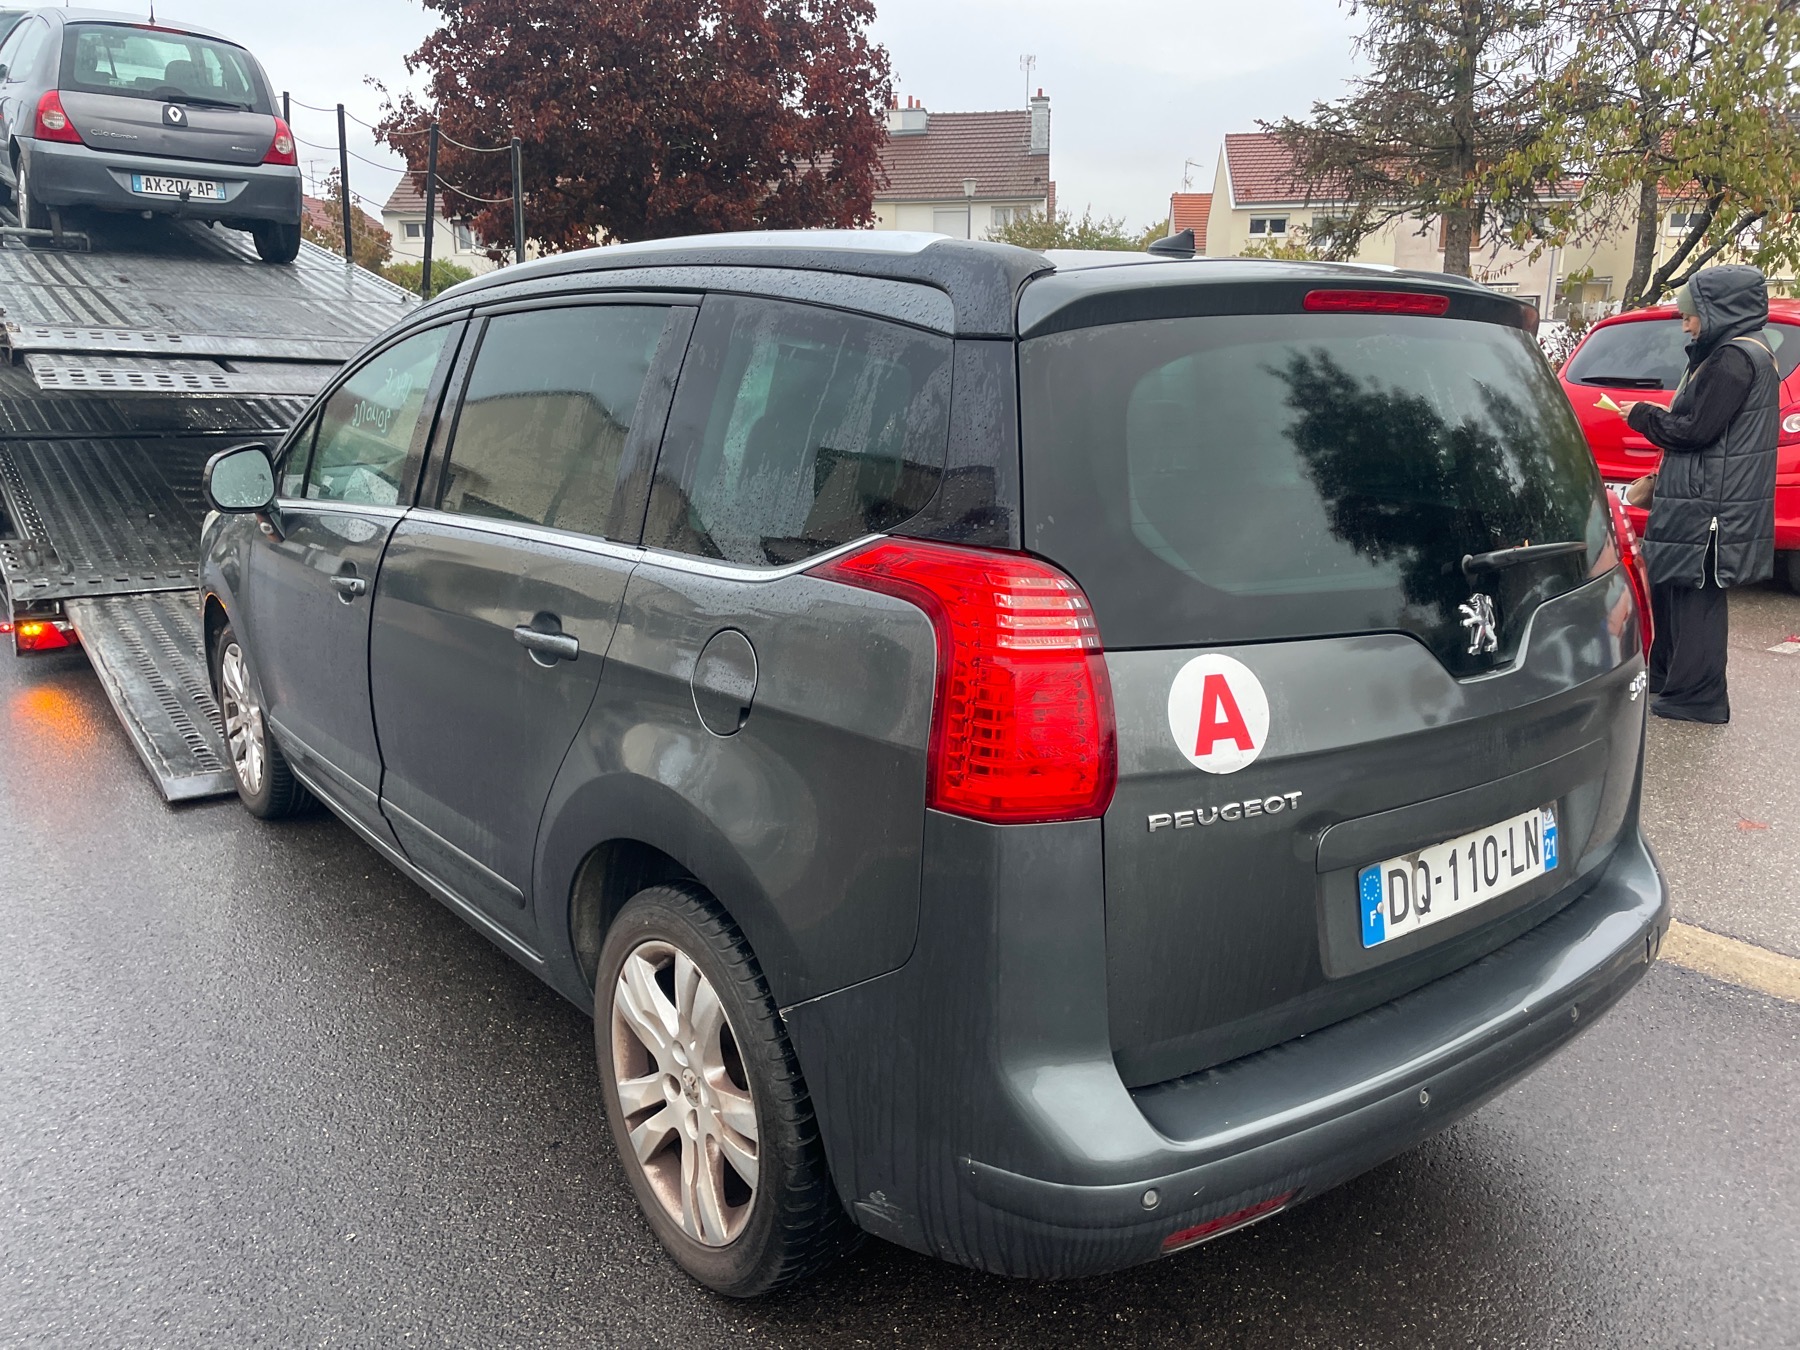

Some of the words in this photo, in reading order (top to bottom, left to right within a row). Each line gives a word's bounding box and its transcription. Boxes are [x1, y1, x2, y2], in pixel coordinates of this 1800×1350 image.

[1194, 673, 1255, 756] A
[1147, 790, 1303, 832] PEUGEOT
[1544, 835, 1556, 860] 21
[1388, 816, 1540, 925] DQ-110-LN
[1369, 909, 1377, 927] F
